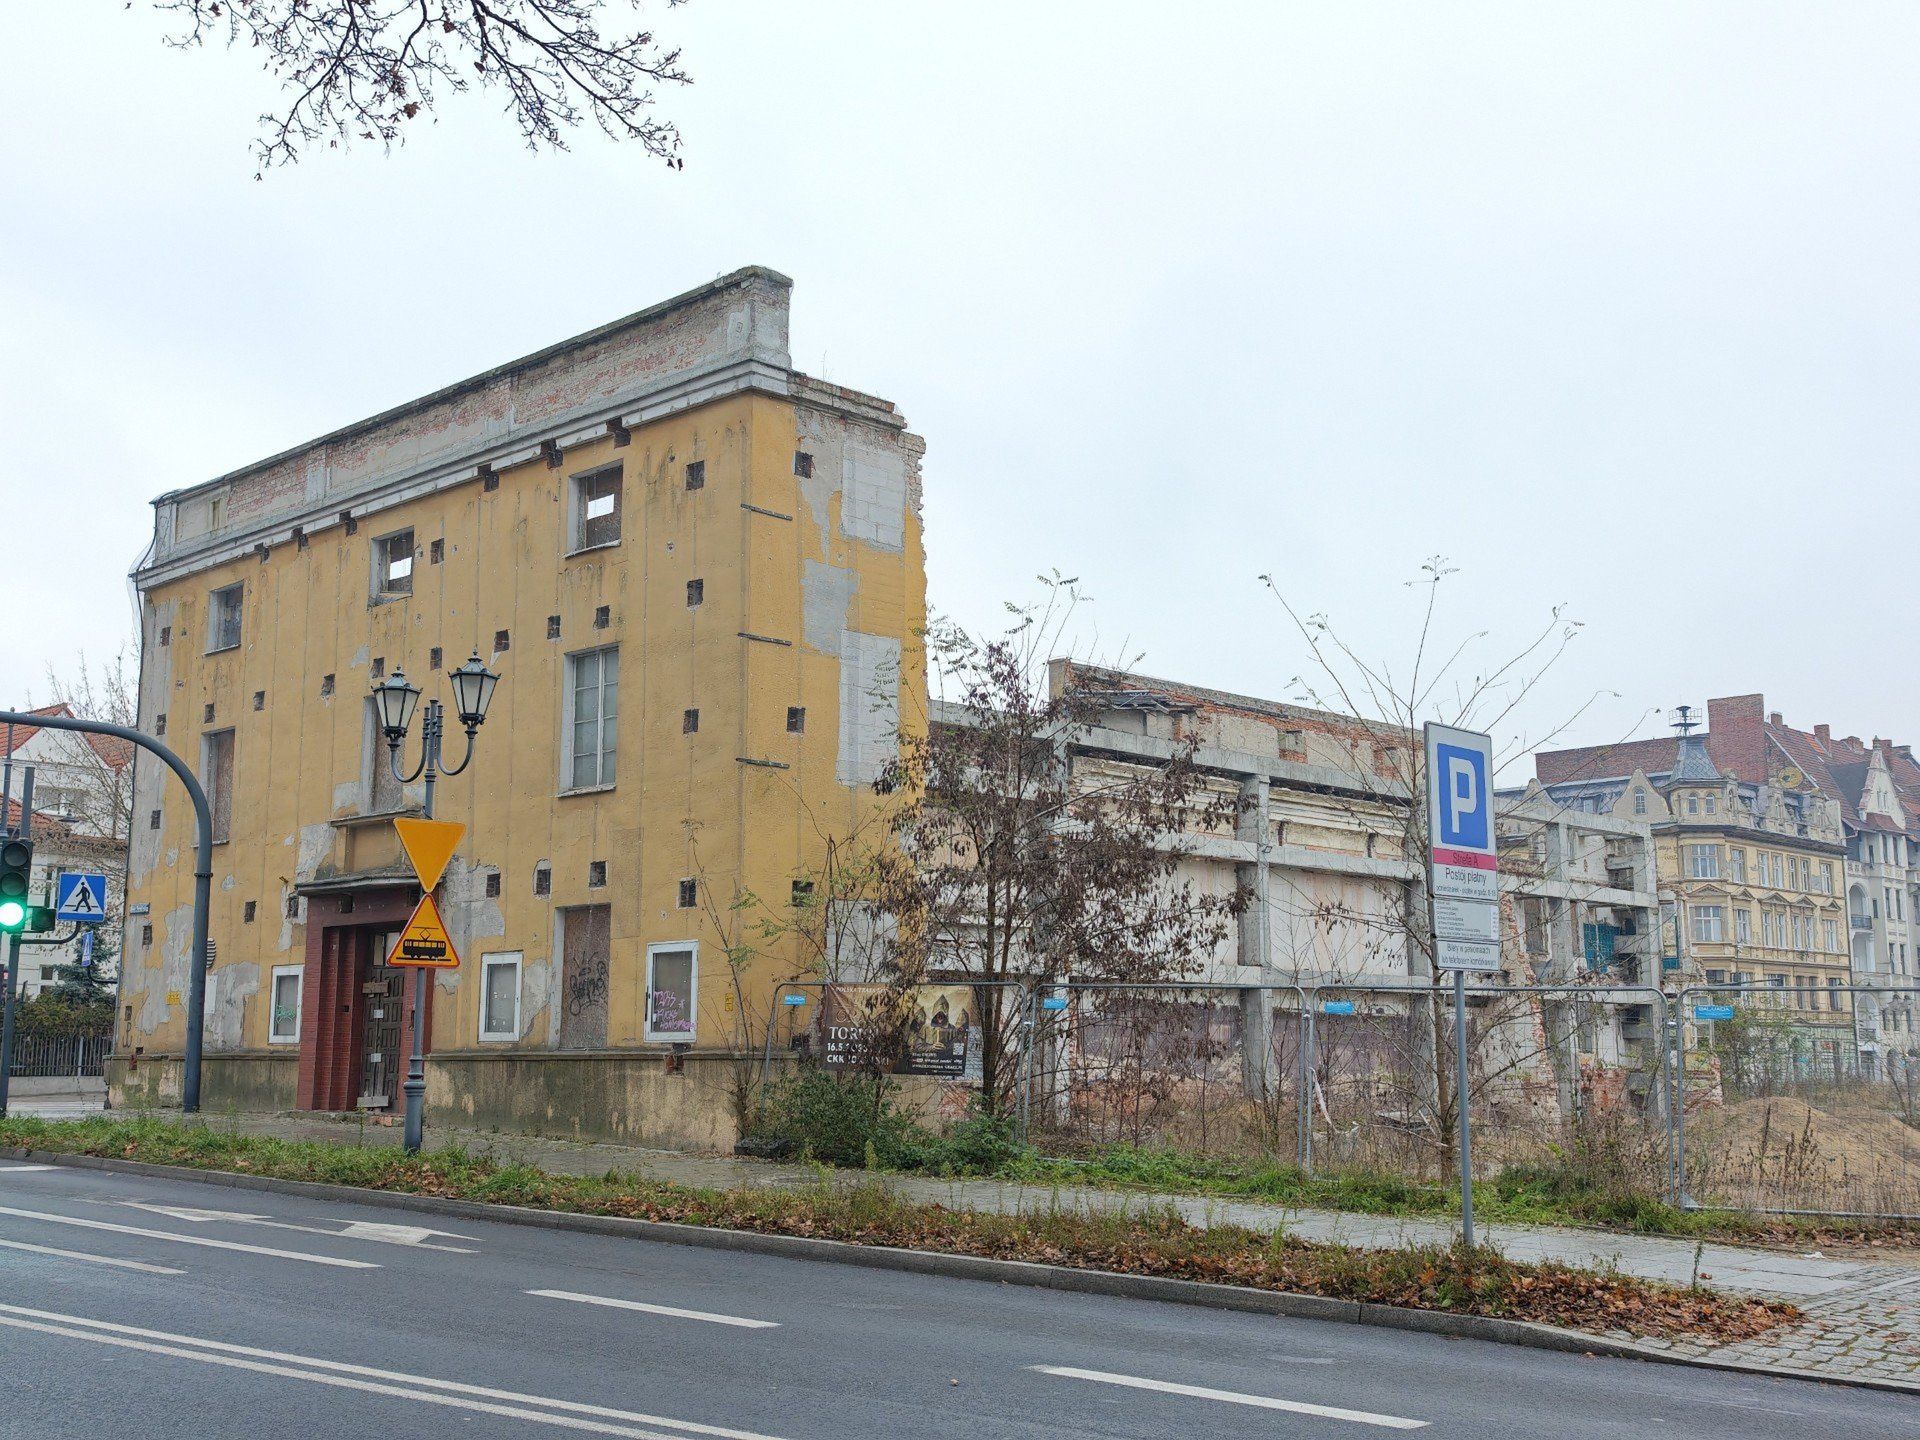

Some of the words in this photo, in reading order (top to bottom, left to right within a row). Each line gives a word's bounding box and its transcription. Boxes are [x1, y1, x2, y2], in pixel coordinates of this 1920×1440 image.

[1448, 756, 1477, 833] P
[1452, 852, 1472, 866] Strefa
[1473, 855, 1479, 867] A
[1445, 867, 1467, 884] Postój
[826, 1054, 845, 1064] CKK
